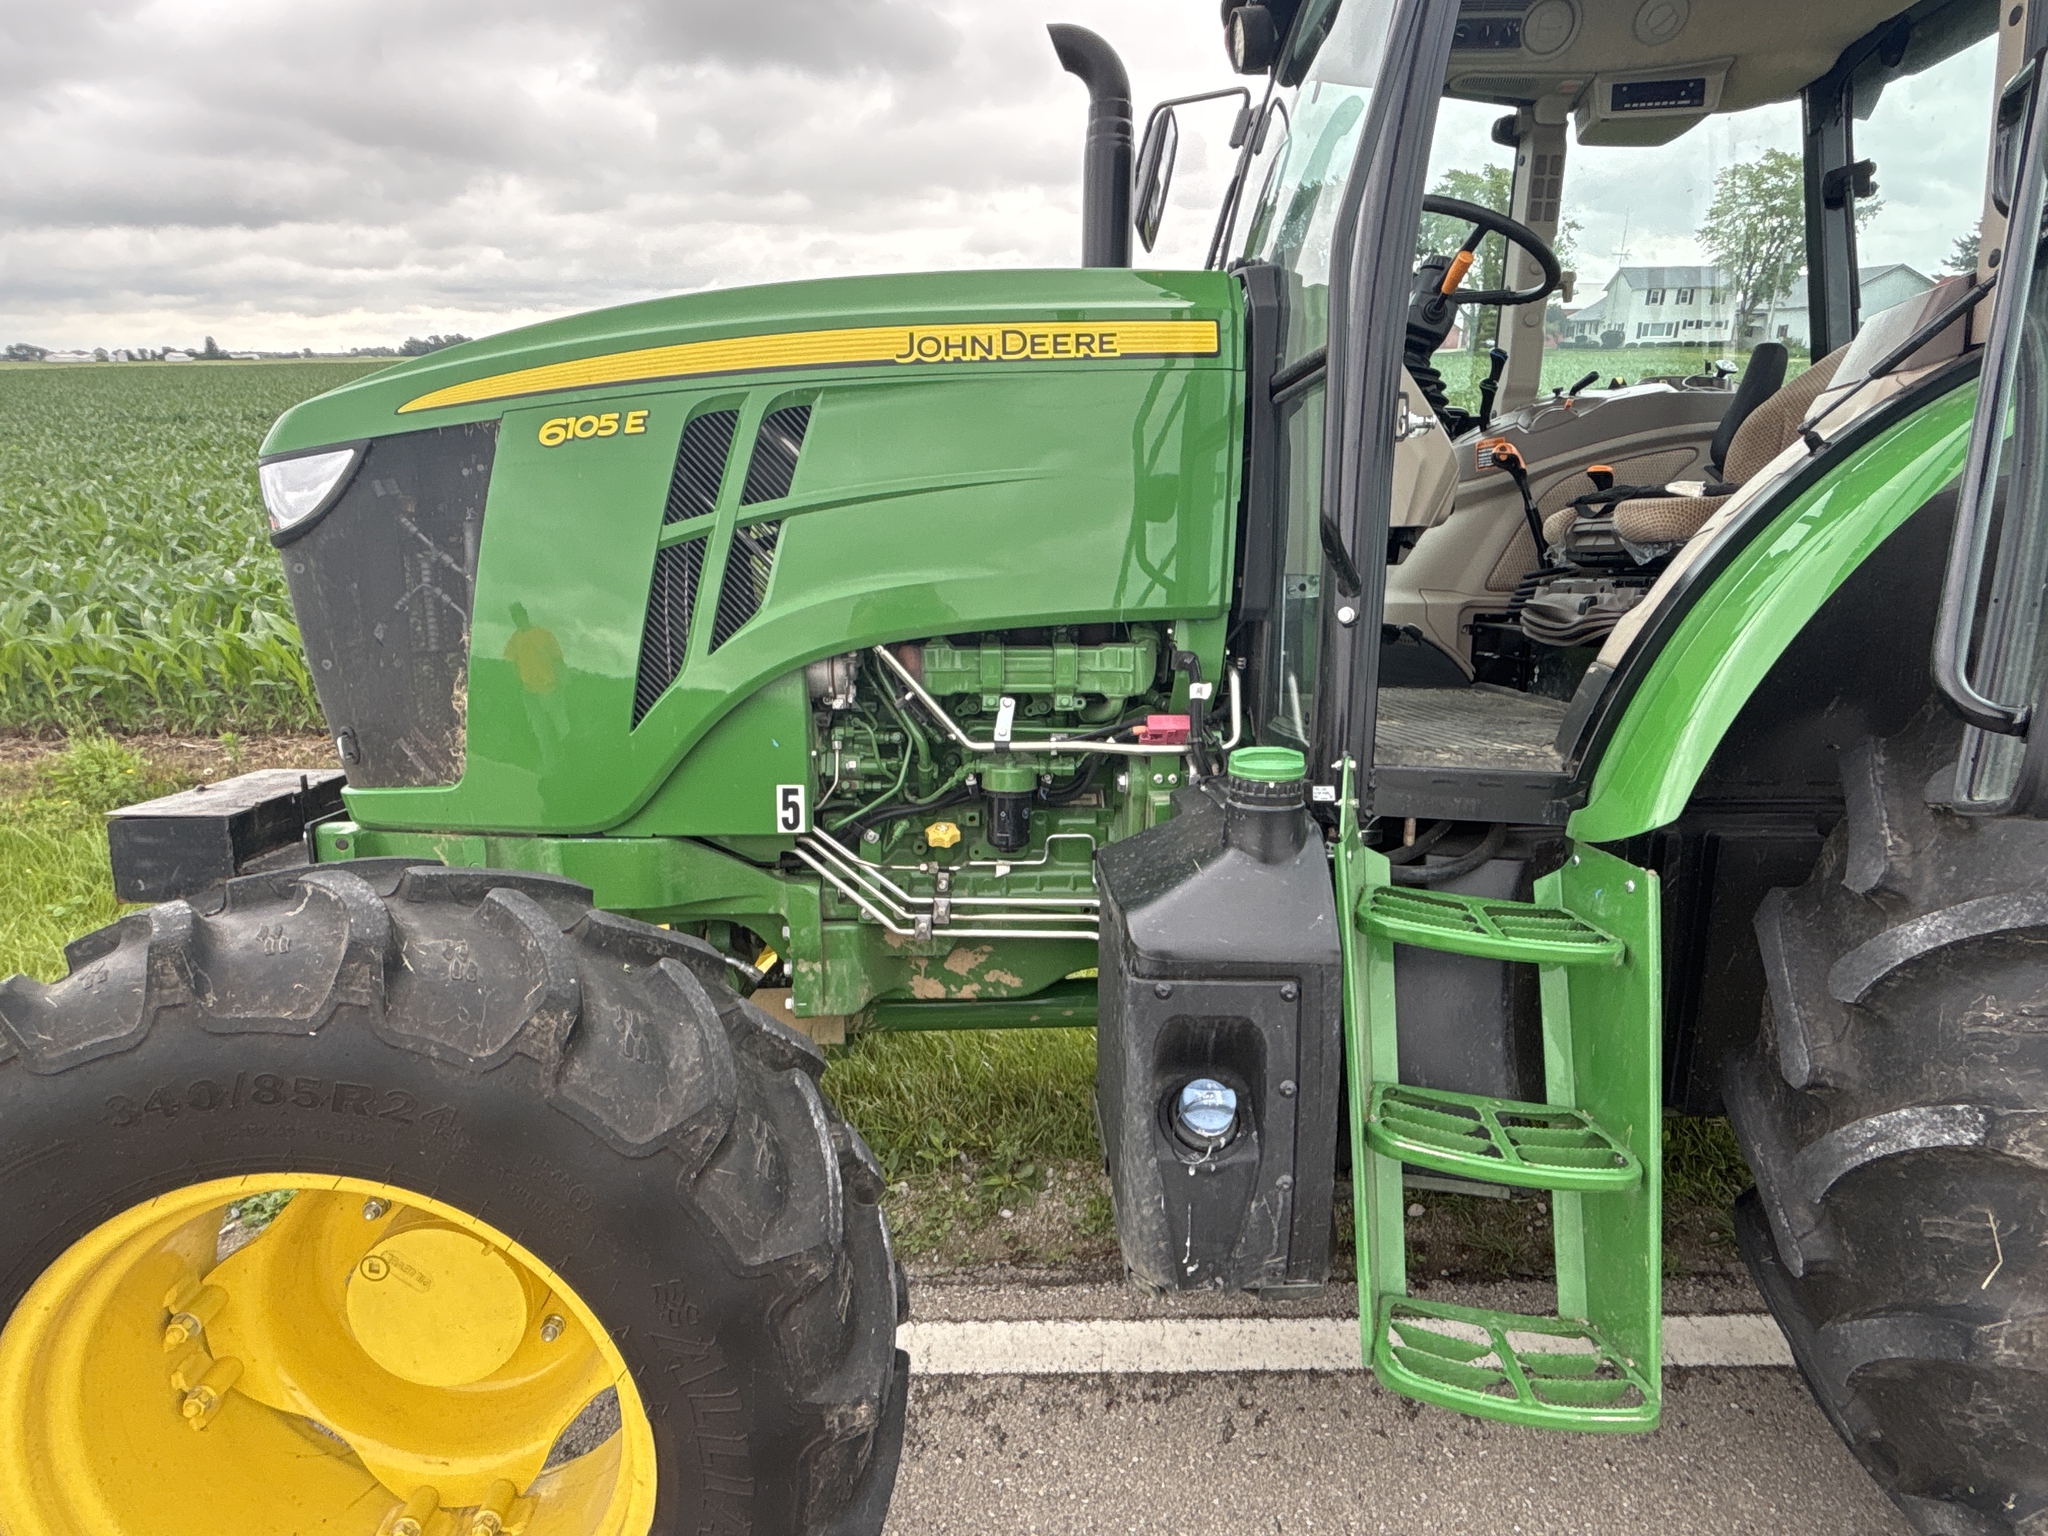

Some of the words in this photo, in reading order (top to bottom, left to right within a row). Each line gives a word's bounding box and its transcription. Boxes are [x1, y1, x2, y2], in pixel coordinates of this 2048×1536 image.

[895, 331, 994, 360] JOHN
[1001, 329, 1117, 356] DEERE
[538, 412, 619, 447] 6105
[624, 410, 649, 434] E
[781, 788, 800, 831] 5
[104, 1070, 459, 1133] 340/85R24
